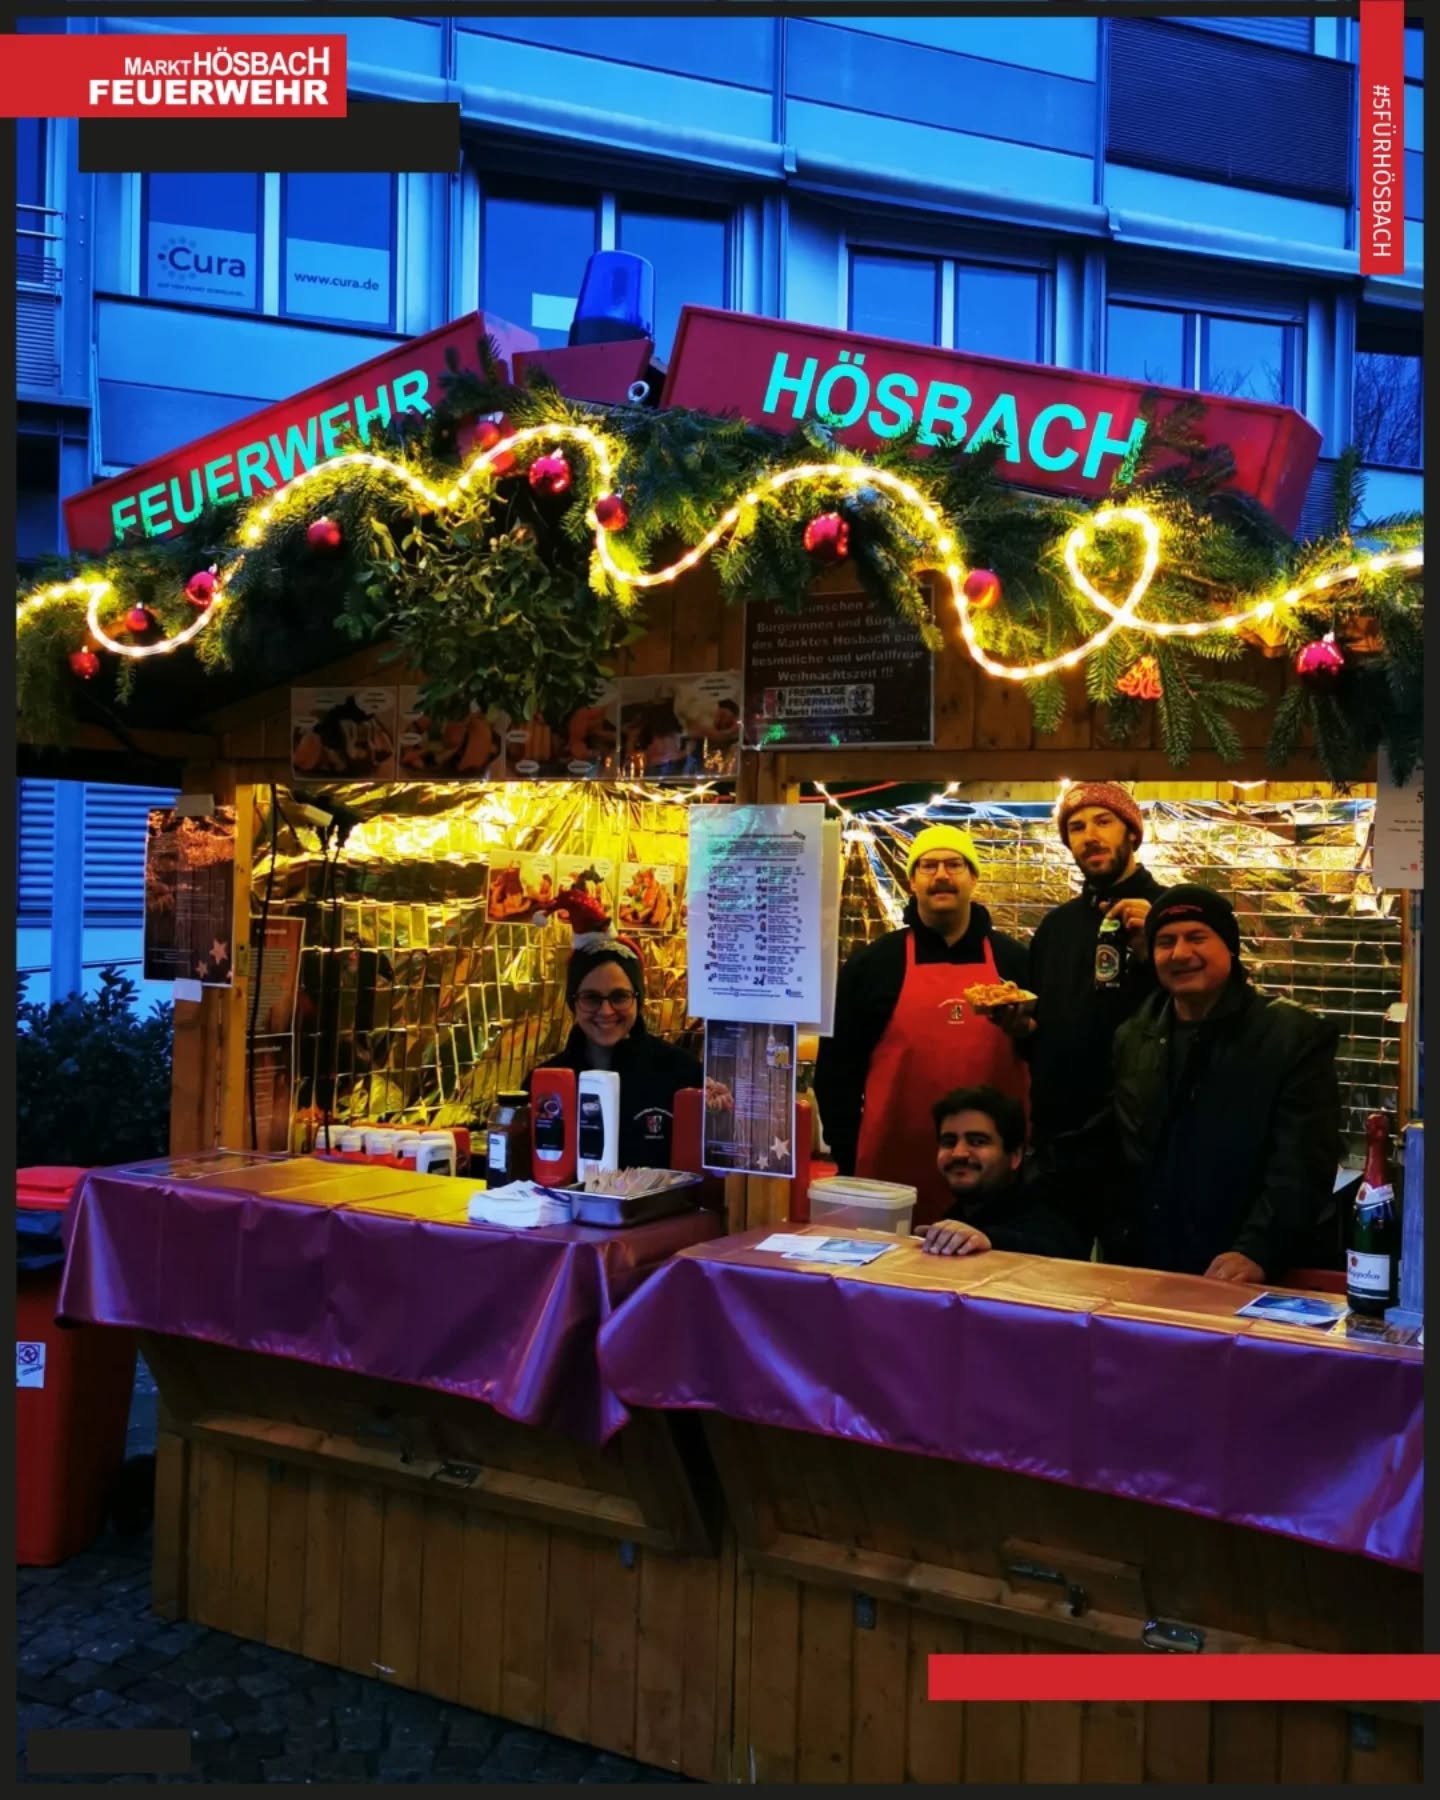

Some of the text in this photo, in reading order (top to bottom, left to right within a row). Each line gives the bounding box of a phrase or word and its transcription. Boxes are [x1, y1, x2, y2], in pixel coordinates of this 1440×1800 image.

[168, 247, 246, 278] Cura
[294, 272, 379, 291] www.cura.de
[111, 369, 435, 541] FEUERWEHR
[763, 350, 1148, 484] HÖSBACH
